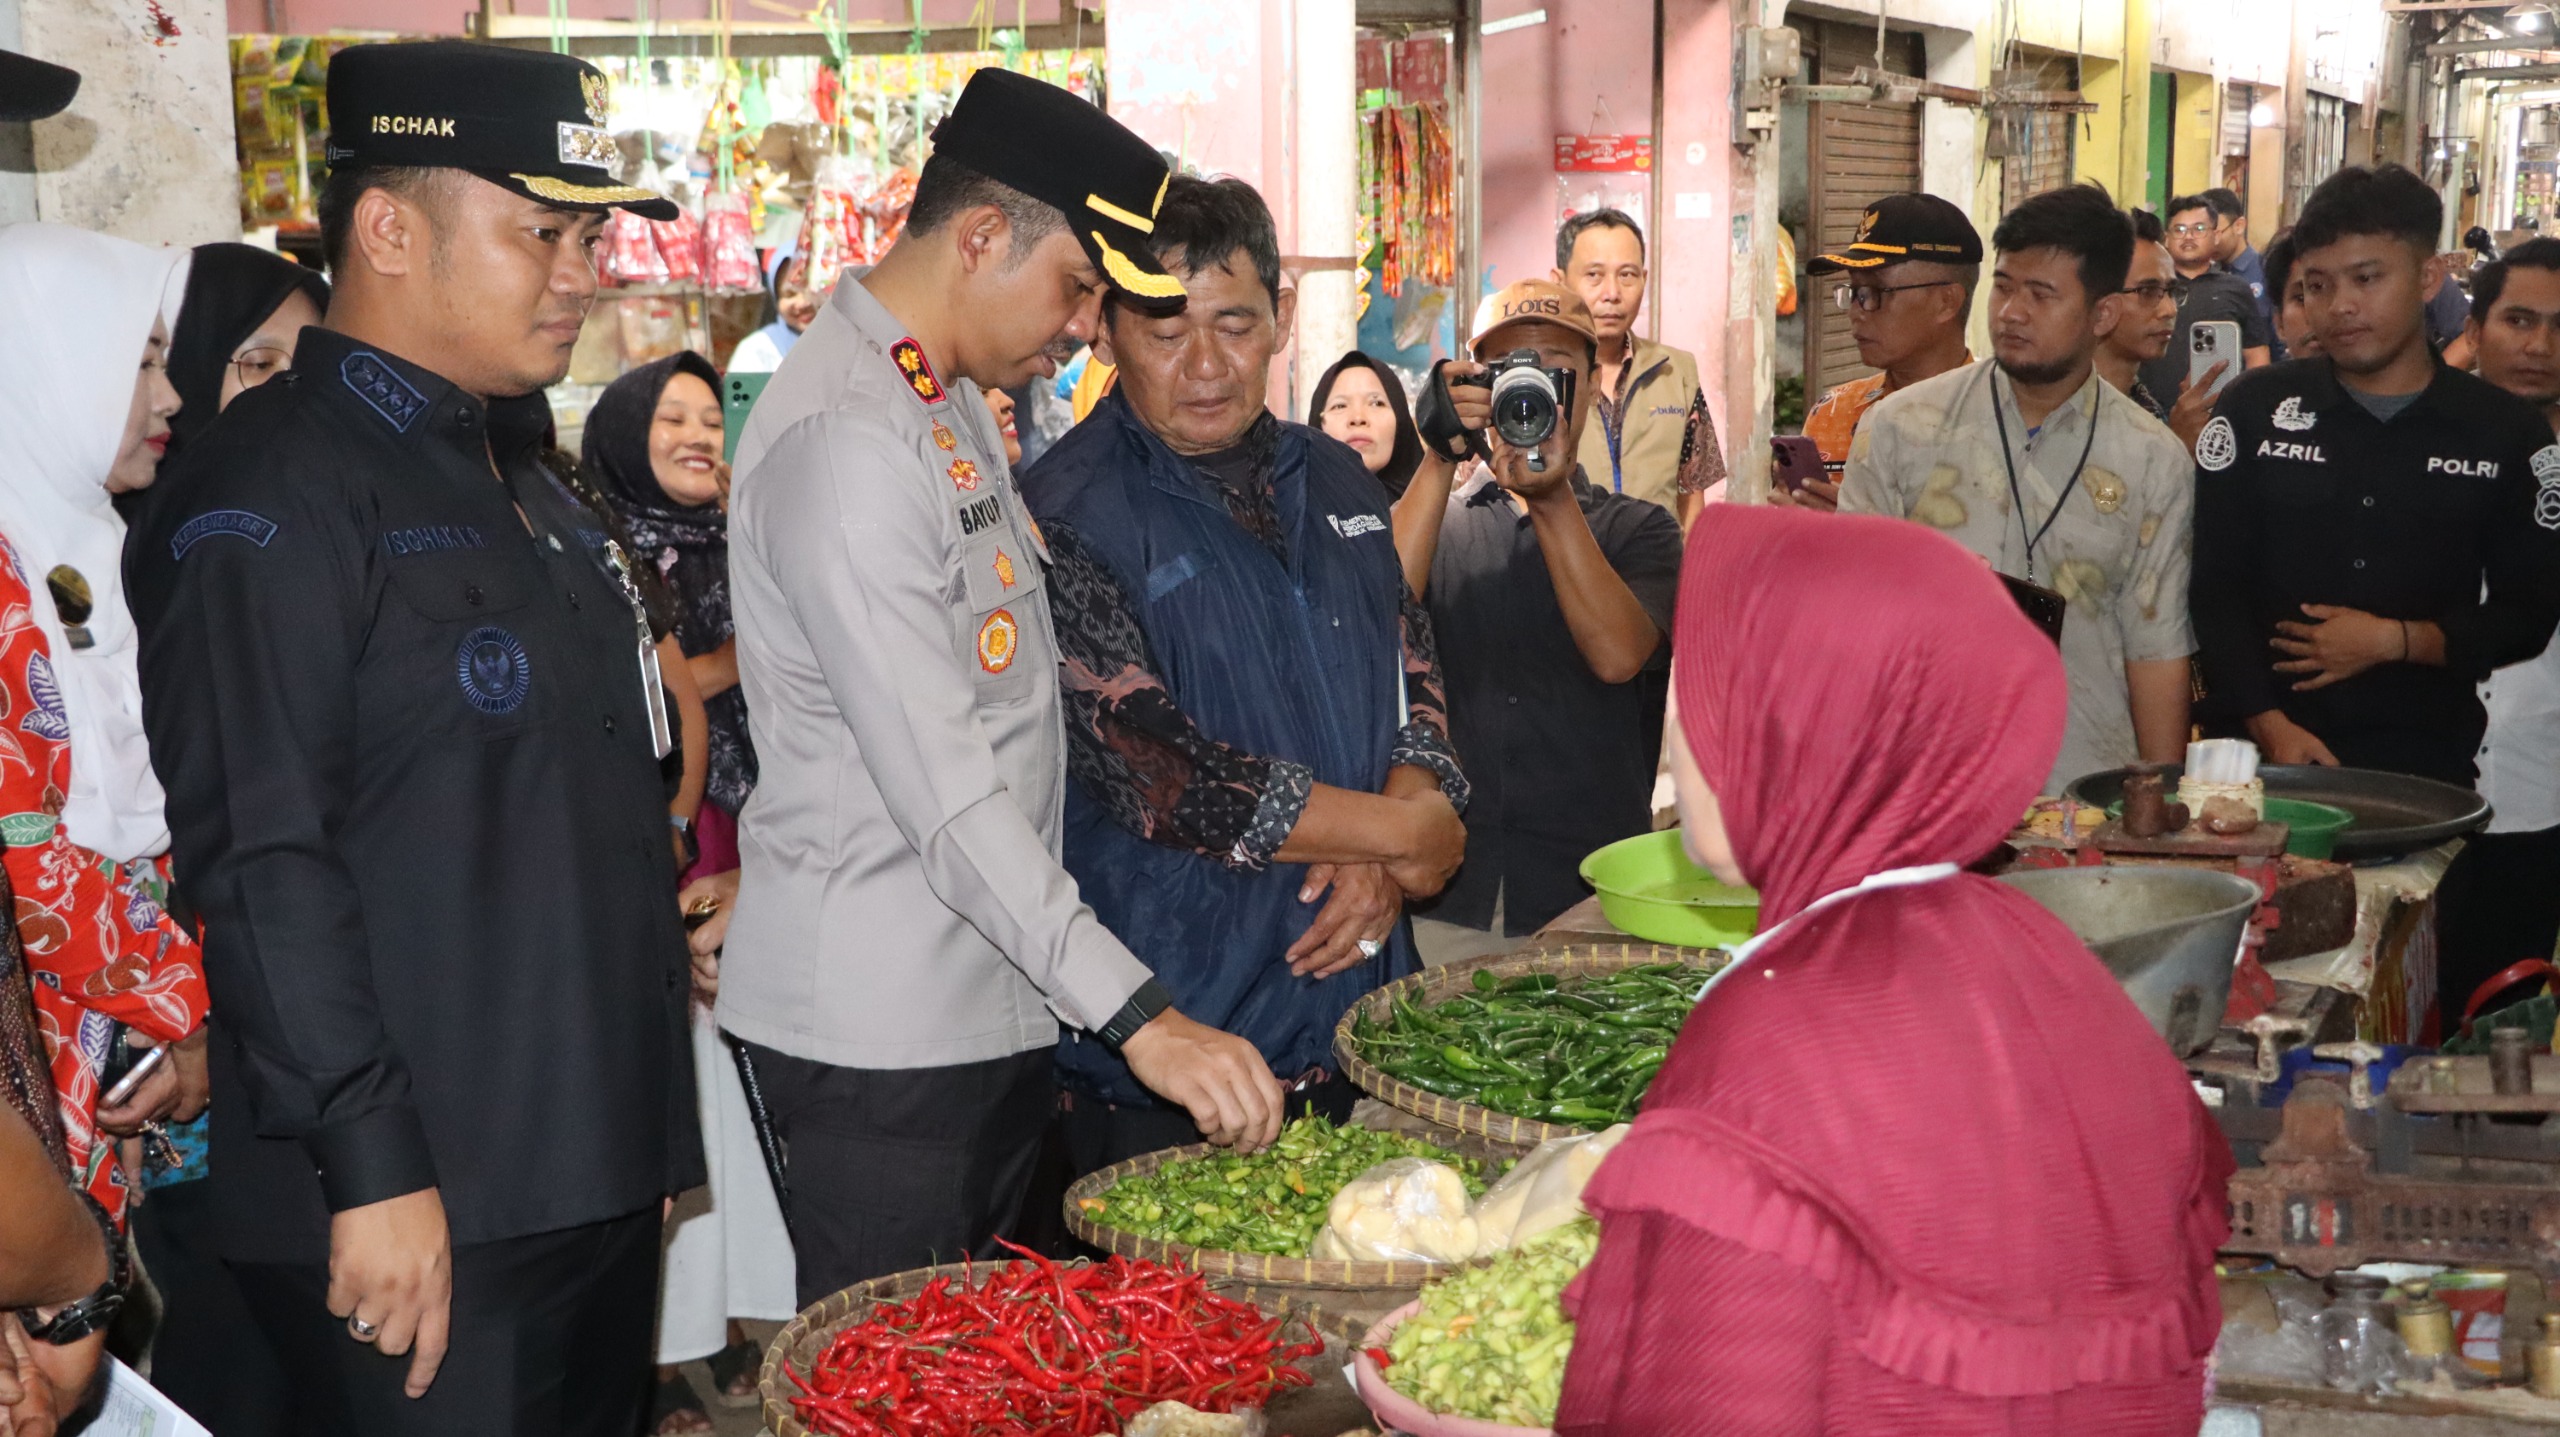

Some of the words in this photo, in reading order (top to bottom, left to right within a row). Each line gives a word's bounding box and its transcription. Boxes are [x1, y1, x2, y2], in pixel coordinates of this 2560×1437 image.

[372, 115, 455, 137] ISCHAK
[1503, 299, 1560, 319] LOIS
[2257, 440, 2326, 462] AZRIL
[2427, 457, 2498, 478] POLRI
